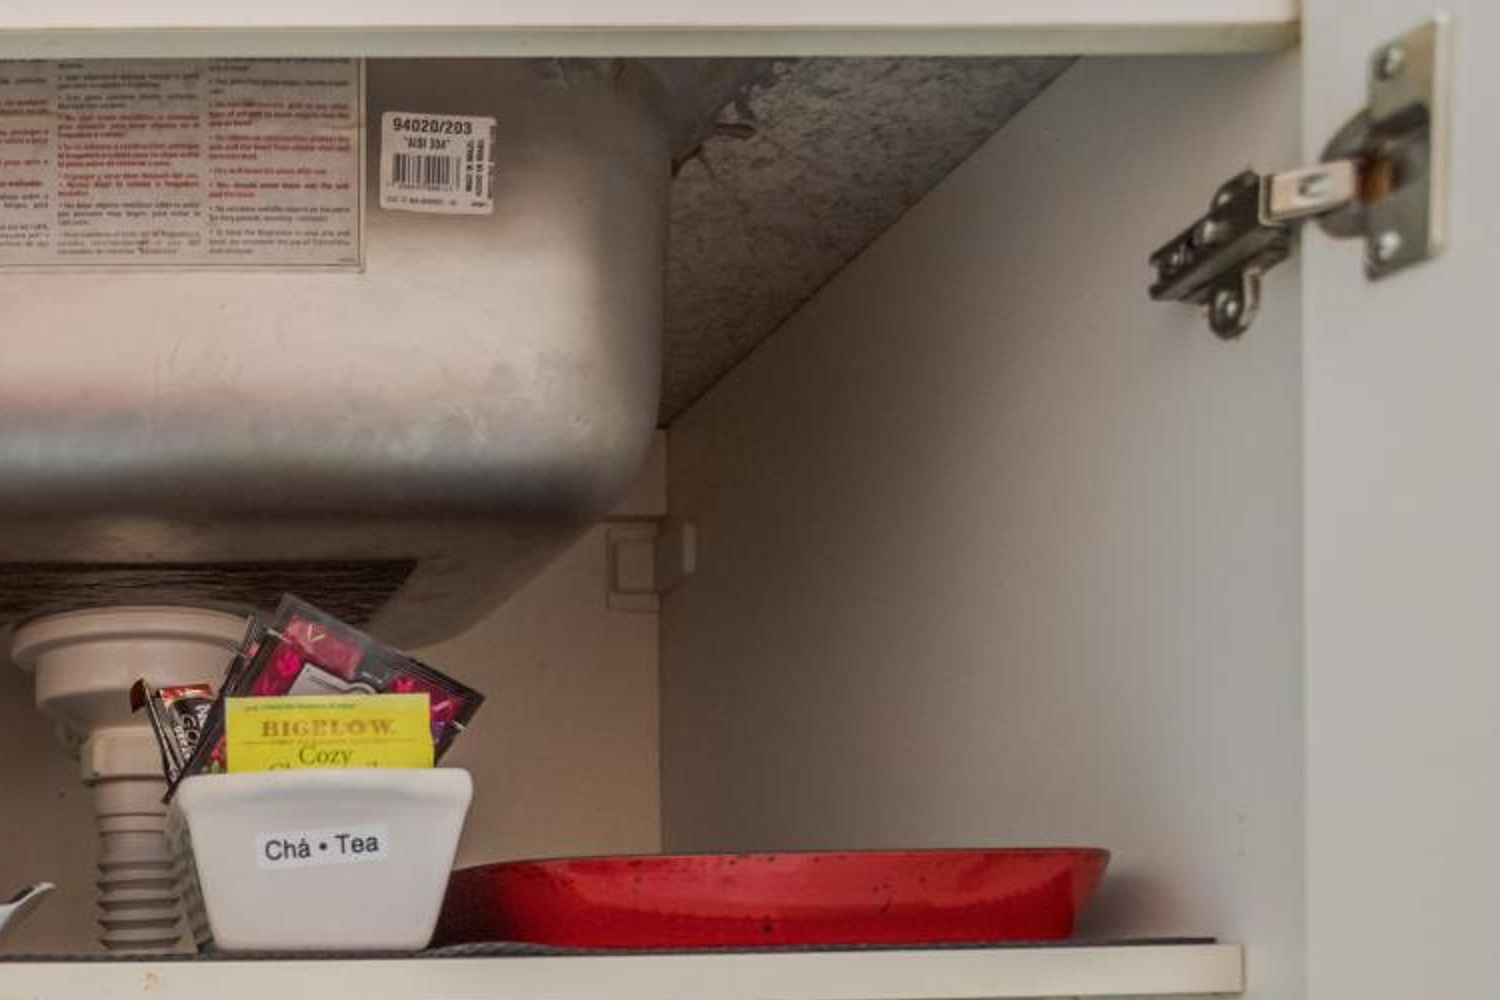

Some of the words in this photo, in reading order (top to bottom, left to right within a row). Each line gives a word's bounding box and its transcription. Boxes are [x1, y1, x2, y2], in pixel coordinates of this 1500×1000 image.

[393, 118, 472, 134] 94020/203
[261, 719, 394, 737] BIGELOW
[298, 747, 354, 767] Cozy
[265, 837, 311, 861] Chá
[333, 833, 380, 854] Tea
